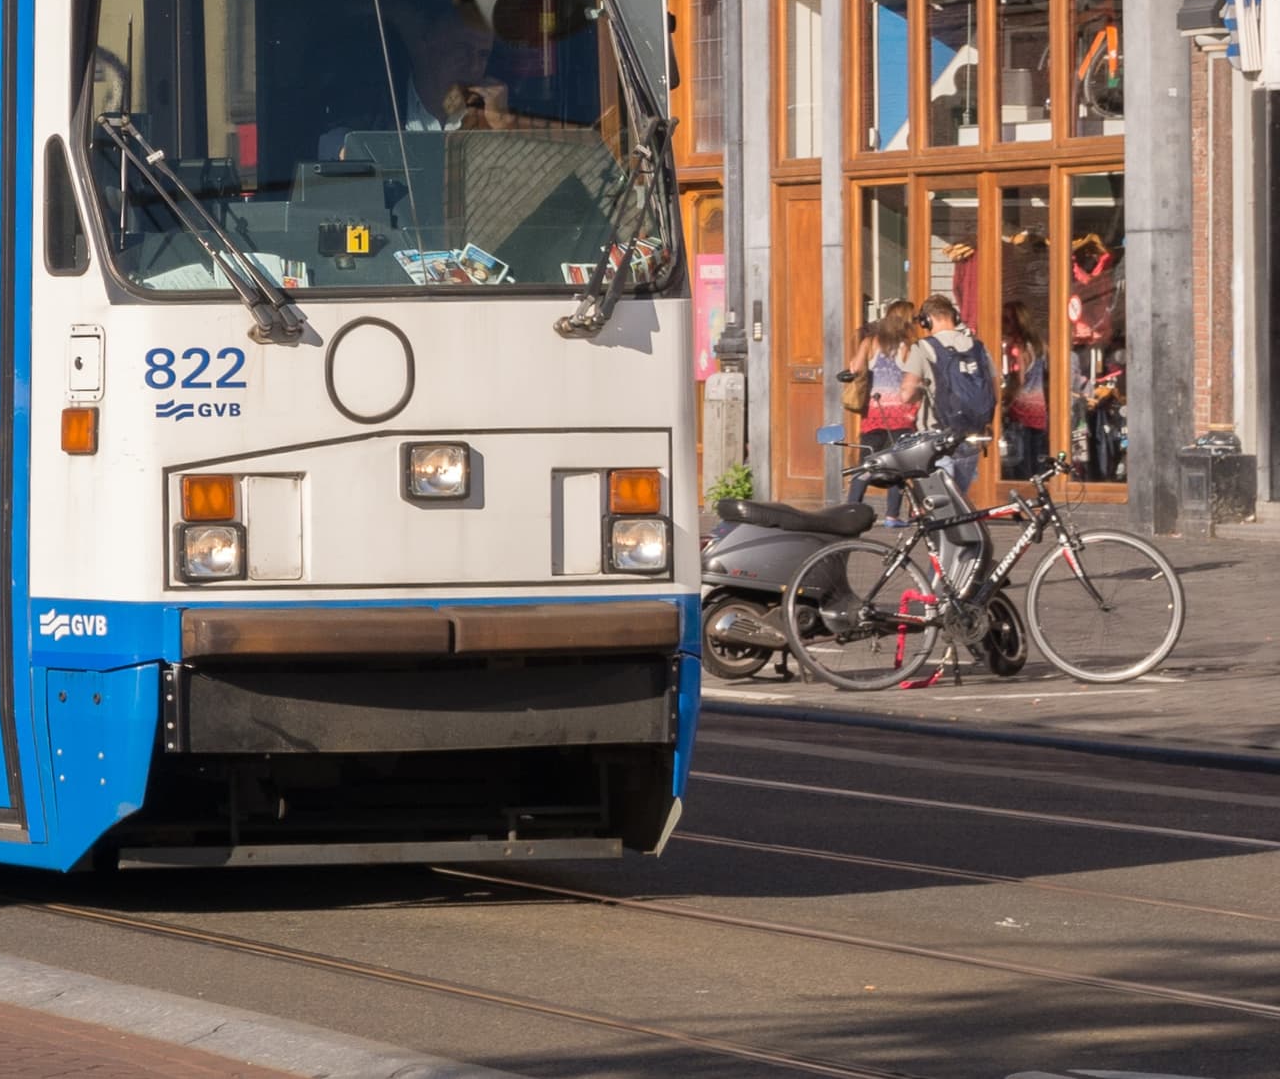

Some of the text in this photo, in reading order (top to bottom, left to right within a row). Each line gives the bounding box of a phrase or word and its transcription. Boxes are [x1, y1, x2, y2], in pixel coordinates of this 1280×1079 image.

[354, 232, 362, 250] 1
[144, 346, 248, 389] 822
[197, 402, 242, 418] GVB
[71, 614, 107, 636] GVB
